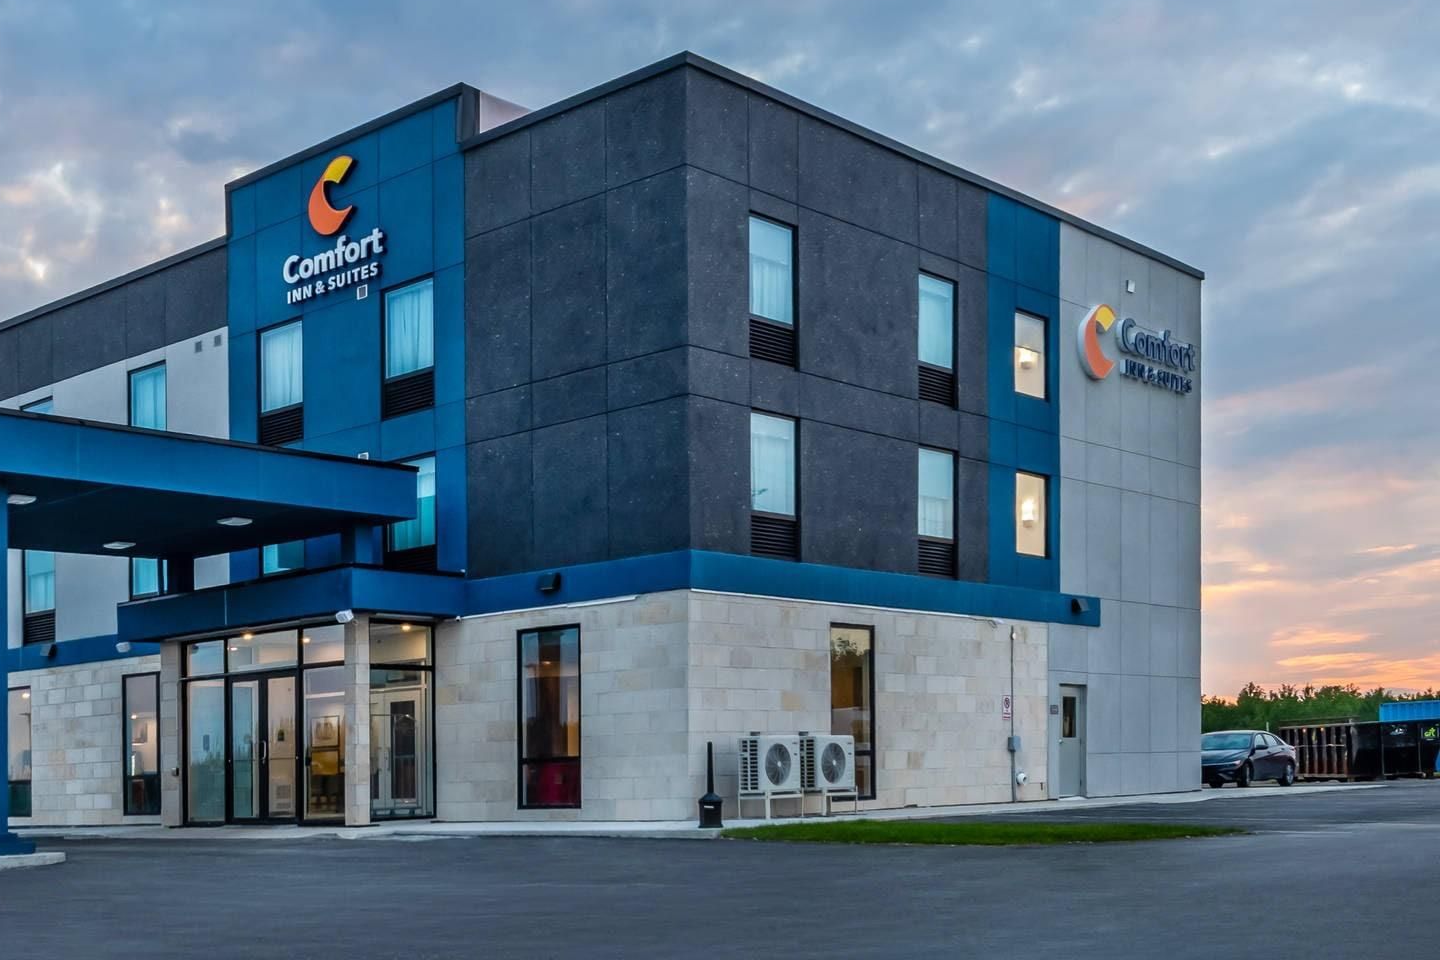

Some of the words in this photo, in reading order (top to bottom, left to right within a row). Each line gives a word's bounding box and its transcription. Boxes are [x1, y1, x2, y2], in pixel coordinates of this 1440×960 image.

[282, 227, 384, 284] Comfort
[287, 284, 313, 305] INN
[315, 280, 326, 295] &
[327, 262, 379, 291] SUITES
[1117, 318, 1195, 371] Comfort
